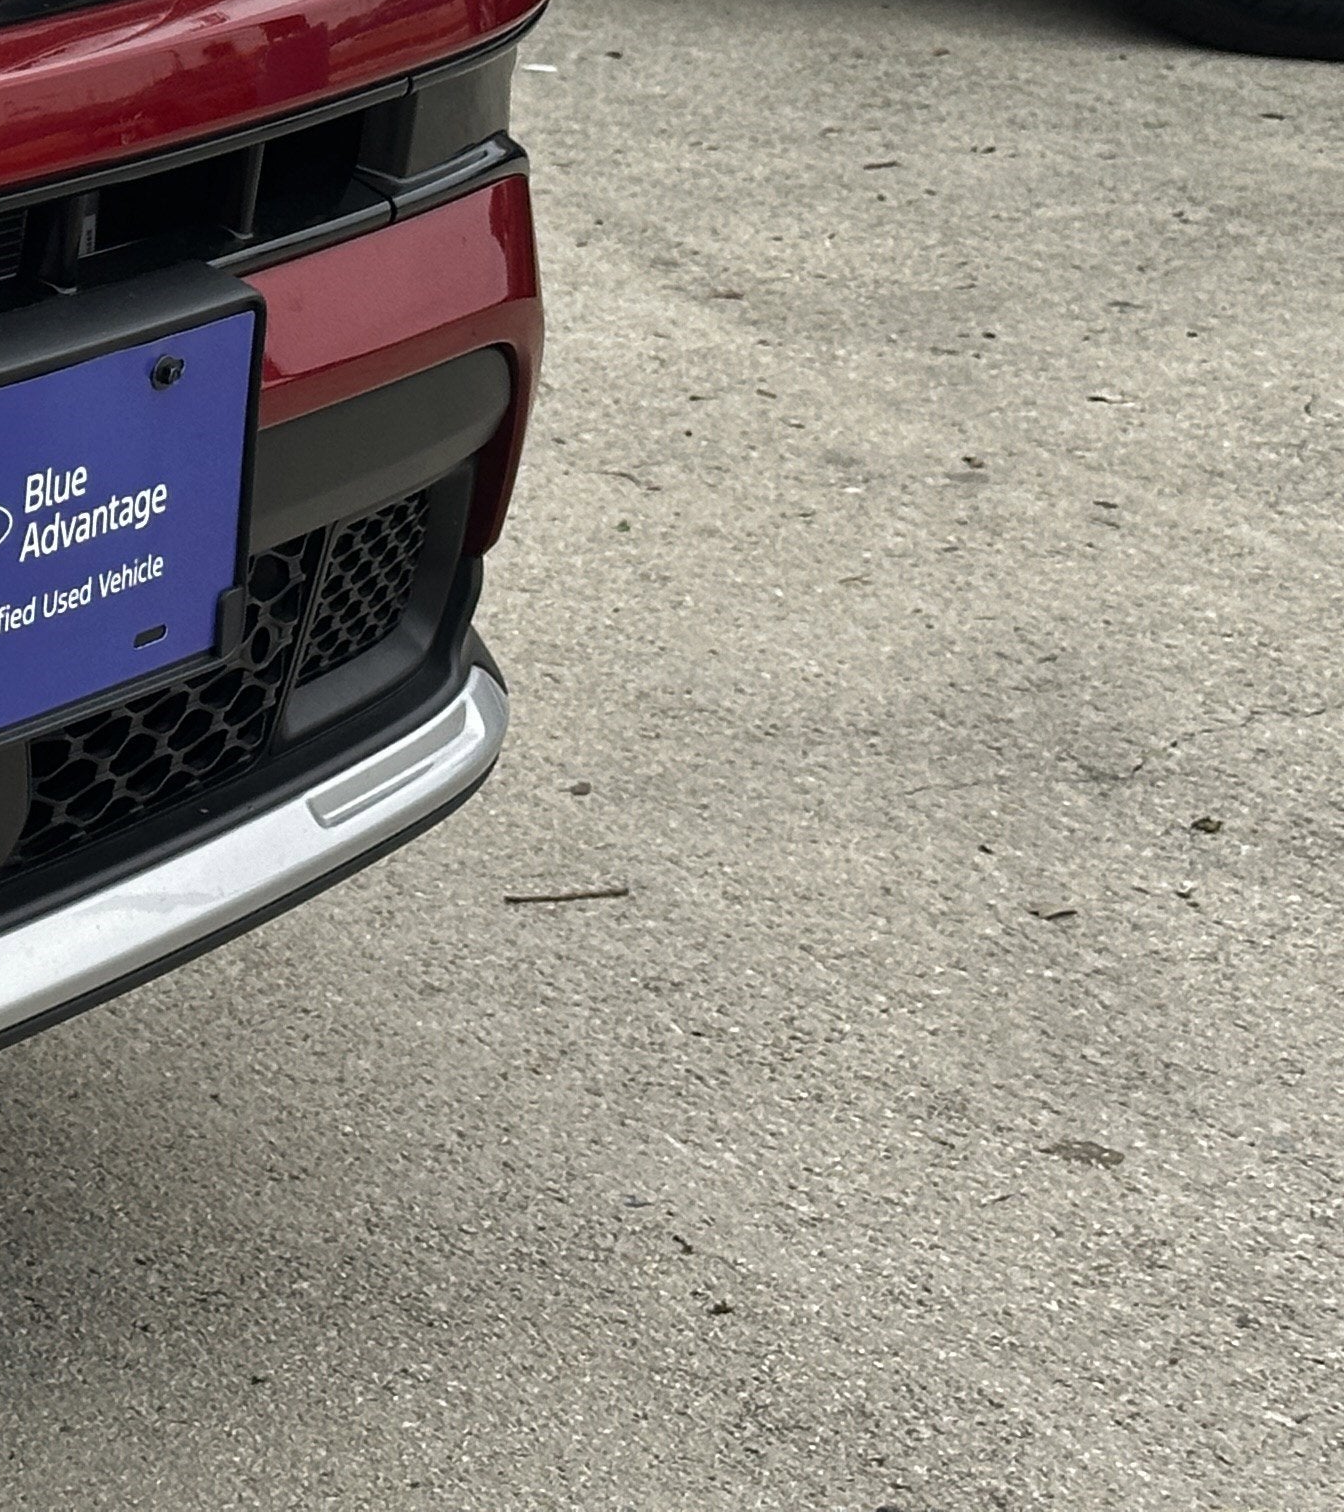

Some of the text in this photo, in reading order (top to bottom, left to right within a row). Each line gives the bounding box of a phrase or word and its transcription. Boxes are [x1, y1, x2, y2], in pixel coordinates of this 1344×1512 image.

[24, 466, 87, 513] Blue
[19, 483, 167, 562] Advantage
[43, 577, 92, 618] Used
[99, 554, 163, 598] Vehicle
